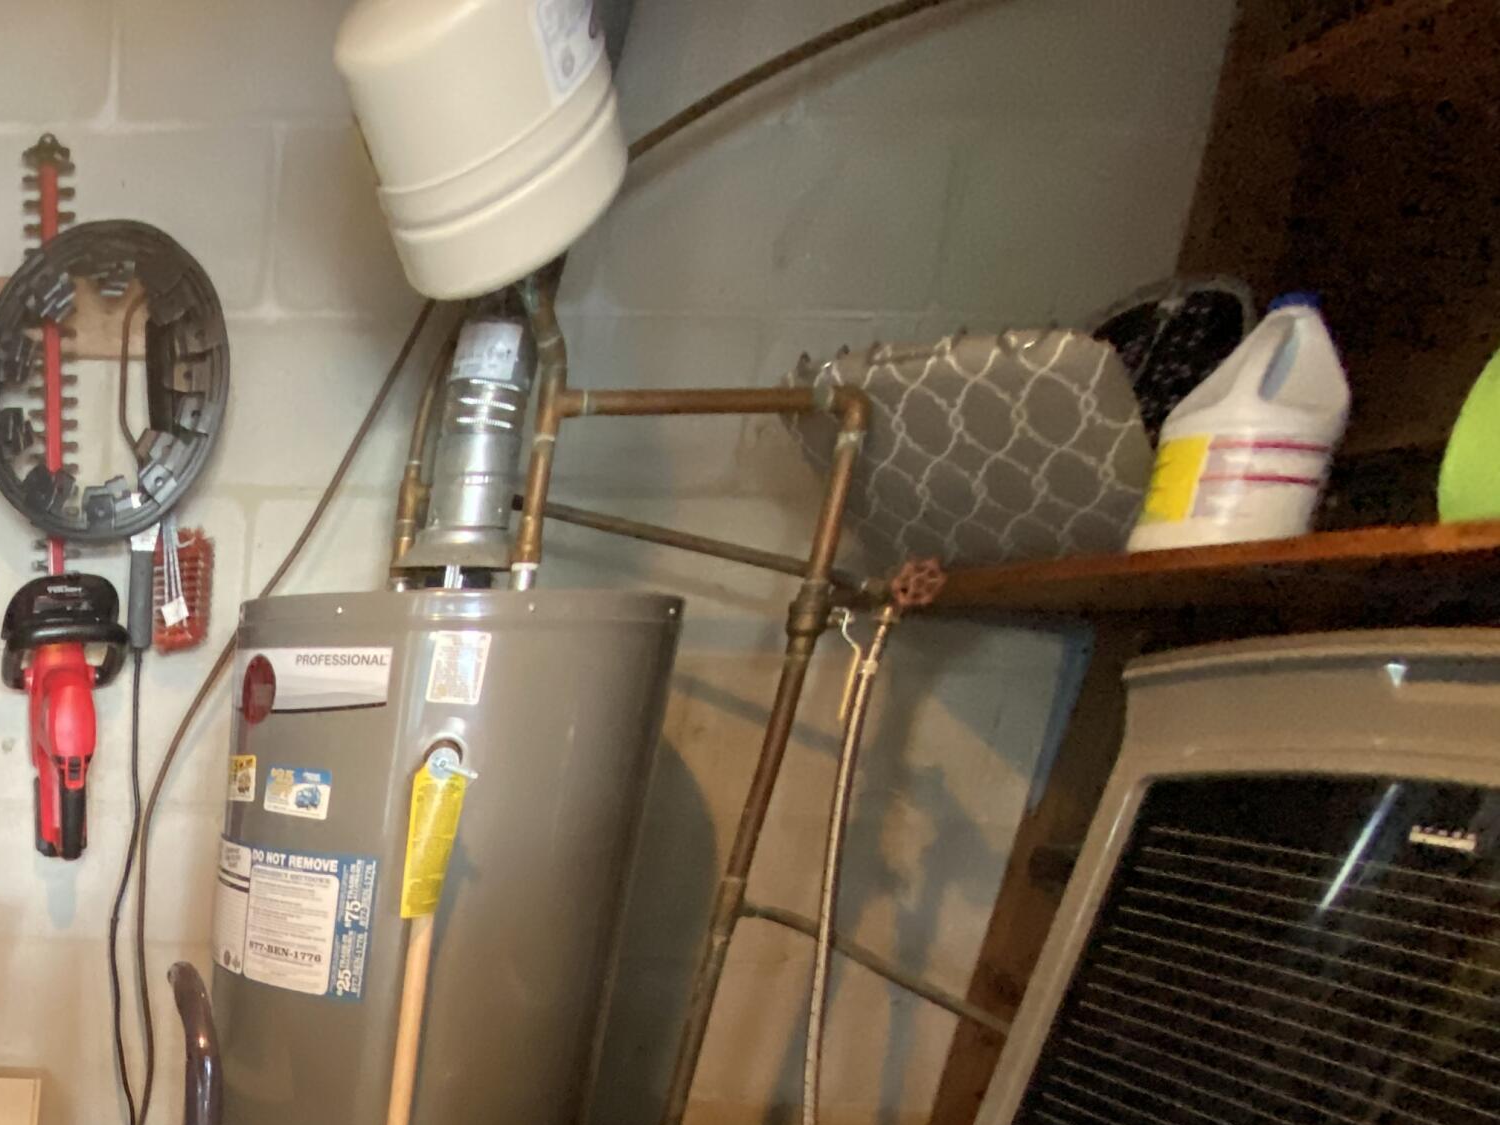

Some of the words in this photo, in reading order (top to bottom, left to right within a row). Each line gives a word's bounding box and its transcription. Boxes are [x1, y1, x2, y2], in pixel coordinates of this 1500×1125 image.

[295, 654, 387, 666] PROFESSIONAL
[252, 849, 265, 862] DO
[266, 851, 287, 867] NOT
[288, 854, 339, 873] REMOVE
